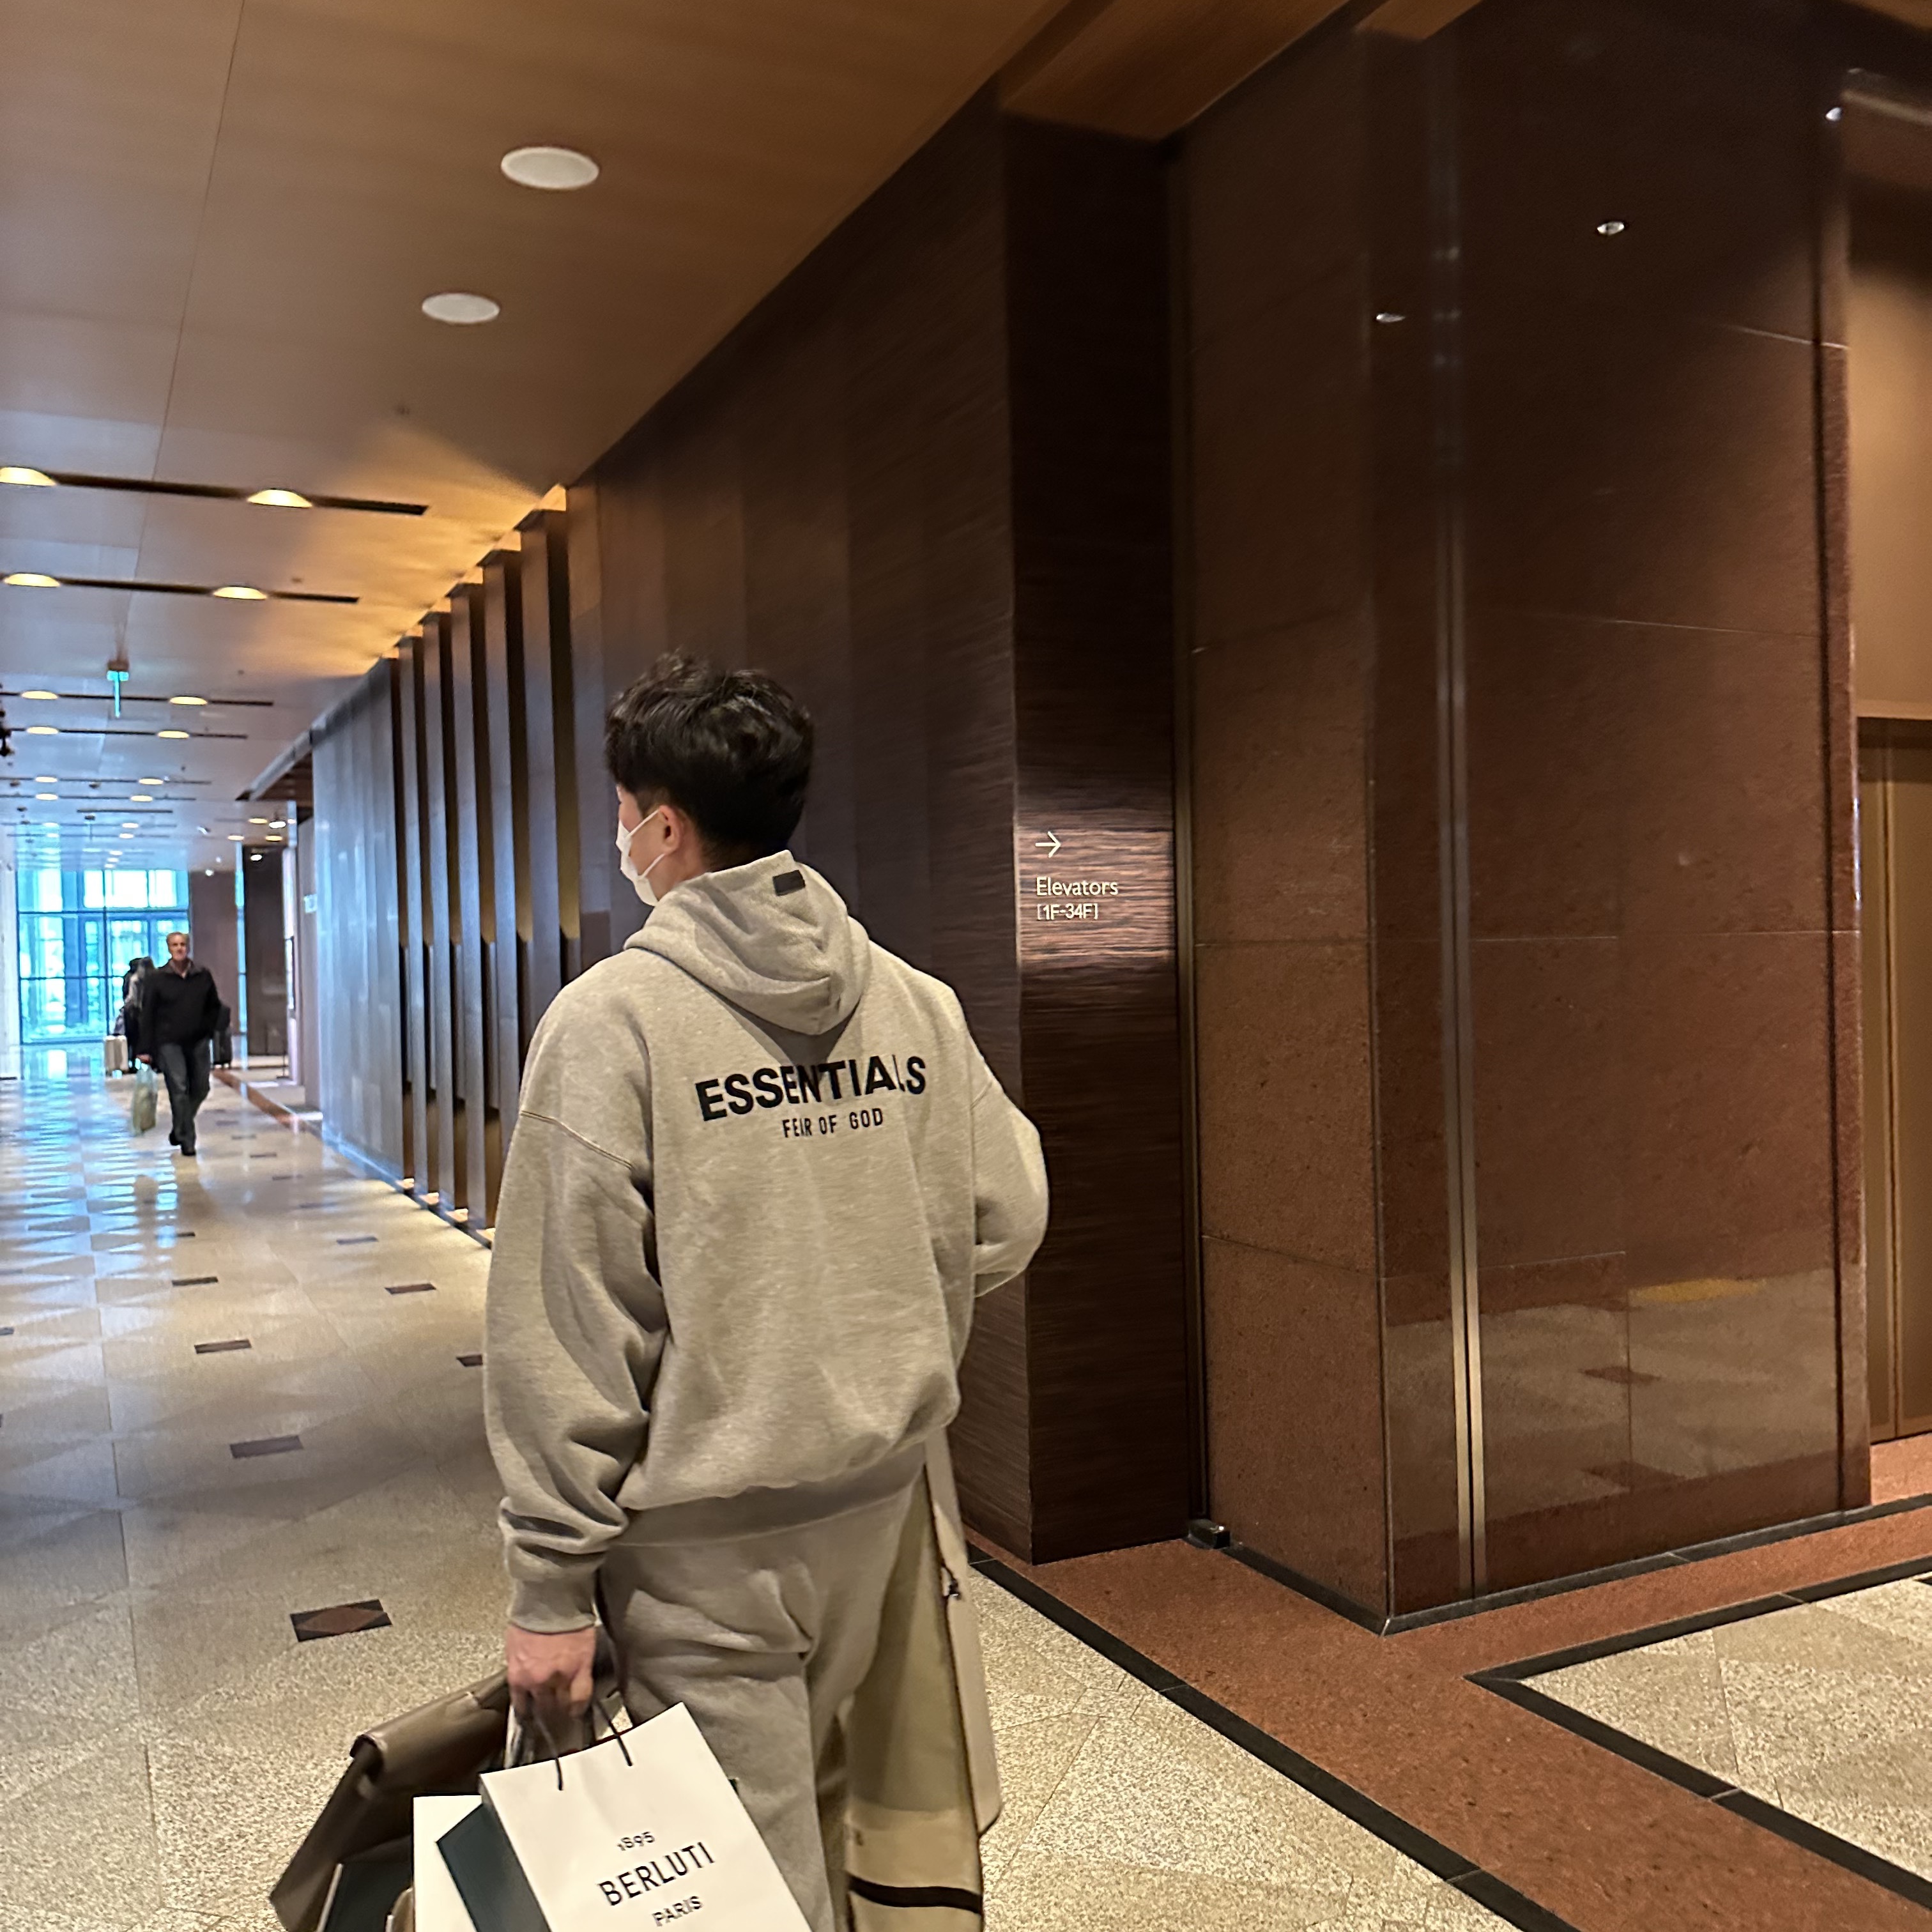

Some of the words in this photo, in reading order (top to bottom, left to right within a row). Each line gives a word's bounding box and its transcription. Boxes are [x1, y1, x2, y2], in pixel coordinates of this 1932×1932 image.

[1036, 876, 1119, 896] Elevators
[1036, 903, 1099, 920] [1F-34F]
[818, 1114, 837, 1135] OF
[849, 1107, 884, 1130] GOD
[596, 1841, 716, 1906] BERLUTI
[652, 1896, 703, 1927] PARIS
